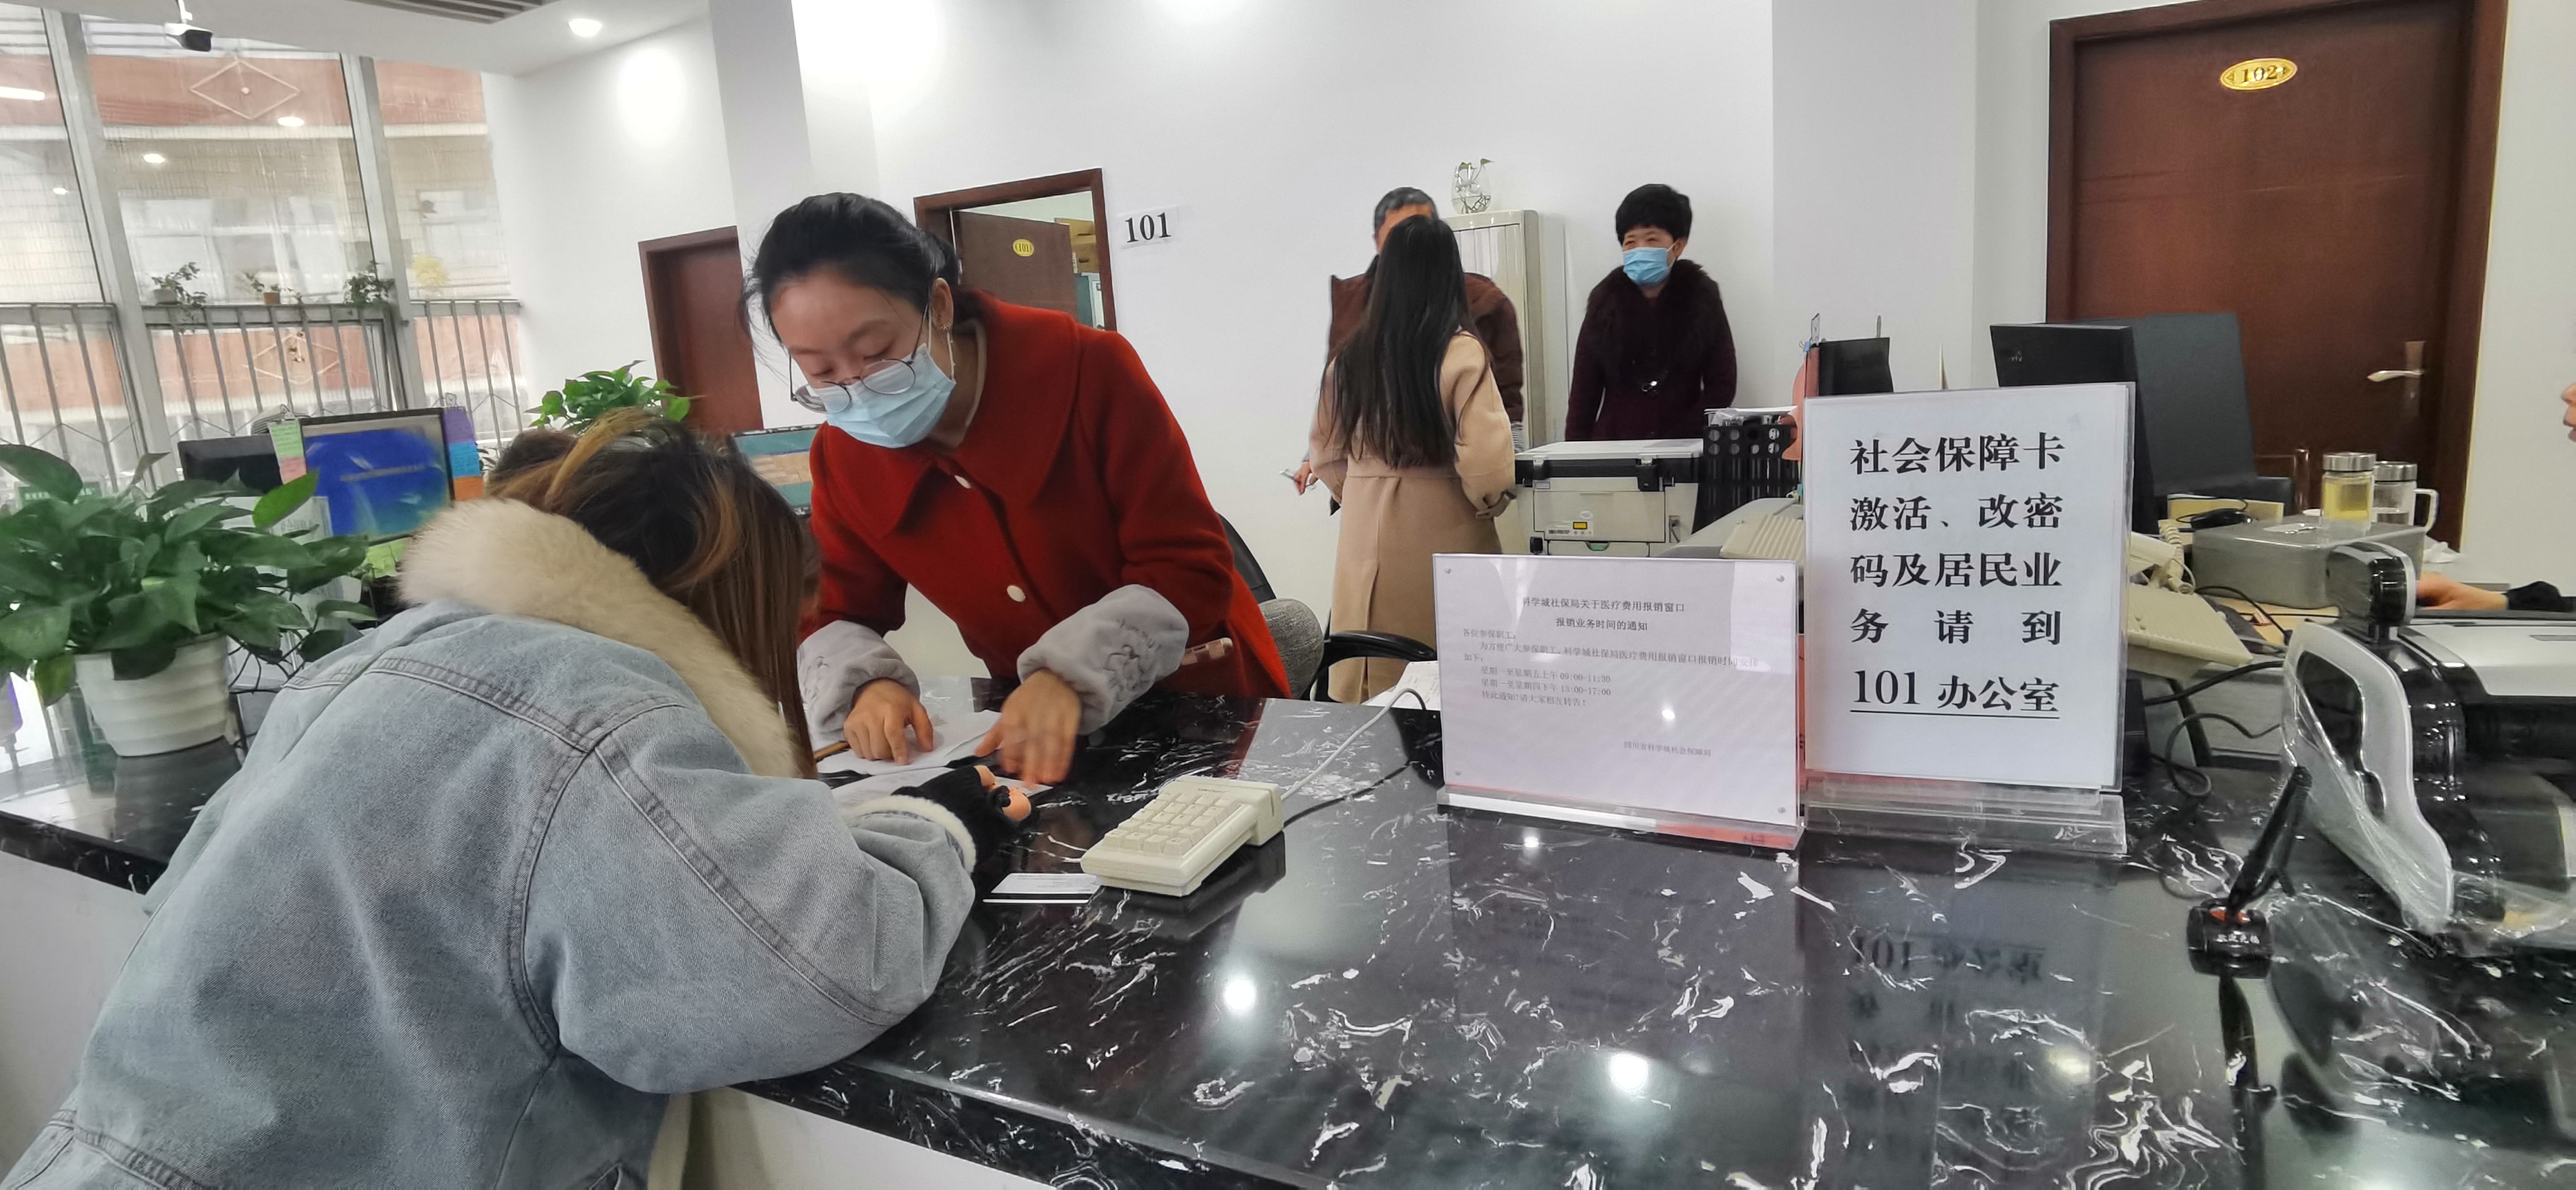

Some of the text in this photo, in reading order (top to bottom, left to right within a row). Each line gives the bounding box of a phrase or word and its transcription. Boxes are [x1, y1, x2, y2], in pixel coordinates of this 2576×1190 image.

[2241, 65, 2277, 83] 102
[1125, 212, 1172, 243] 101
[1019, 243, 1029, 252] 101
[1850, 432, 2064, 475] 社会保障卡
[1850, 552, 2061, 588] 码及居民业
[1555, 617, 1648, 631] 报销业务时间的通知
